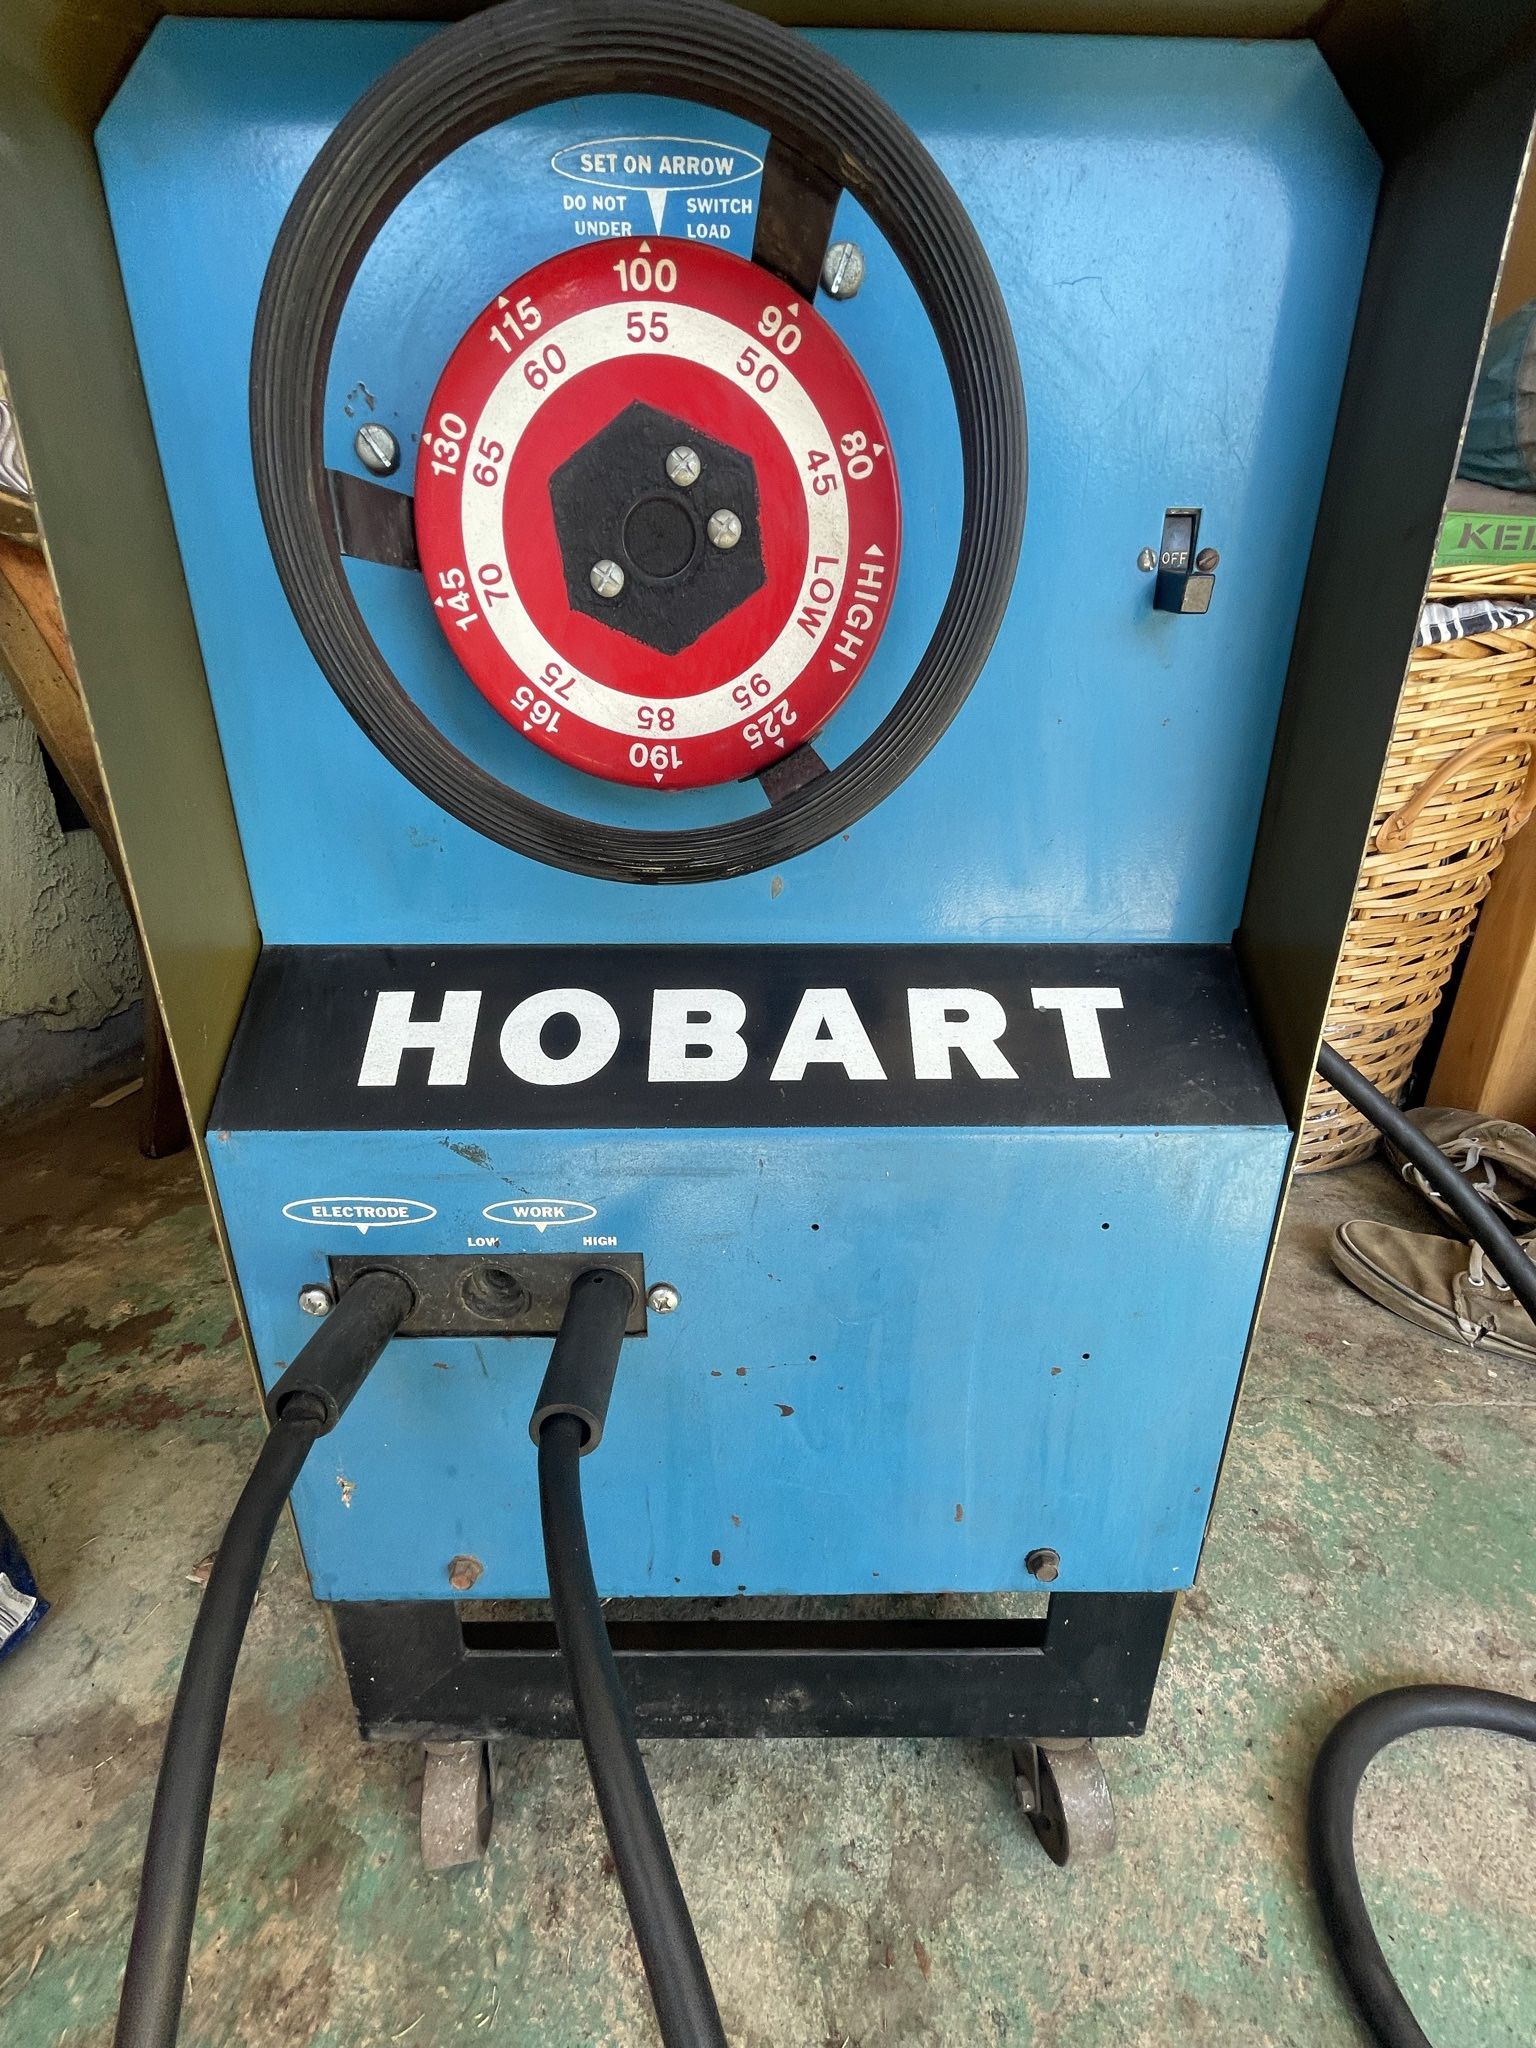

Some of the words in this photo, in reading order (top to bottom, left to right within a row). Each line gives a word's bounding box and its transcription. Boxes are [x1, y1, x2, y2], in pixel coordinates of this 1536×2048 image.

[580, 153, 618, 174] SET
[623, 156, 652, 175] ON
[658, 155, 734, 176] ARROW
[563, 195, 587, 211] DO
[592, 195, 627, 211] NOT
[686, 198, 752, 215] SWITCH
[574, 221, 632, 237] UNDER
[687, 224, 731, 239] LOAD
[613, 258, 677, 293] 100
[488, 296, 543, 354] 115
[626, 310, 669, 344] 55
[756, 305, 802, 356] 90
[522, 342, 567, 391] 60
[735, 346, 779, 395] 50
[433, 412, 468, 477] 130
[471, 438, 505, 488] 65
[840, 429, 874, 480] 80
[806, 447, 839, 497] 45
[1162, 551, 1187, 565] OFF
[439, 567, 478, 632] 145
[477, 562, 510, 608] 70
[797, 554, 840, 640] LOW
[834, 561, 885, 661] HIGH
[539, 660, 580, 701] 75
[732, 672, 771, 711] 95
[510, 685, 560, 733] 165
[637, 705, 675, 731] 85
[742, 698, 797, 749] 225
[629, 741, 683, 769] 190
[357, 987, 1124, 1087] HOBART
[311, 1206, 409, 1219] ELECTRODE
[513, 1206, 565, 1218] WORK
[467, 1236, 501, 1248] LOW
[582, 1235, 618, 1247] HIGH
